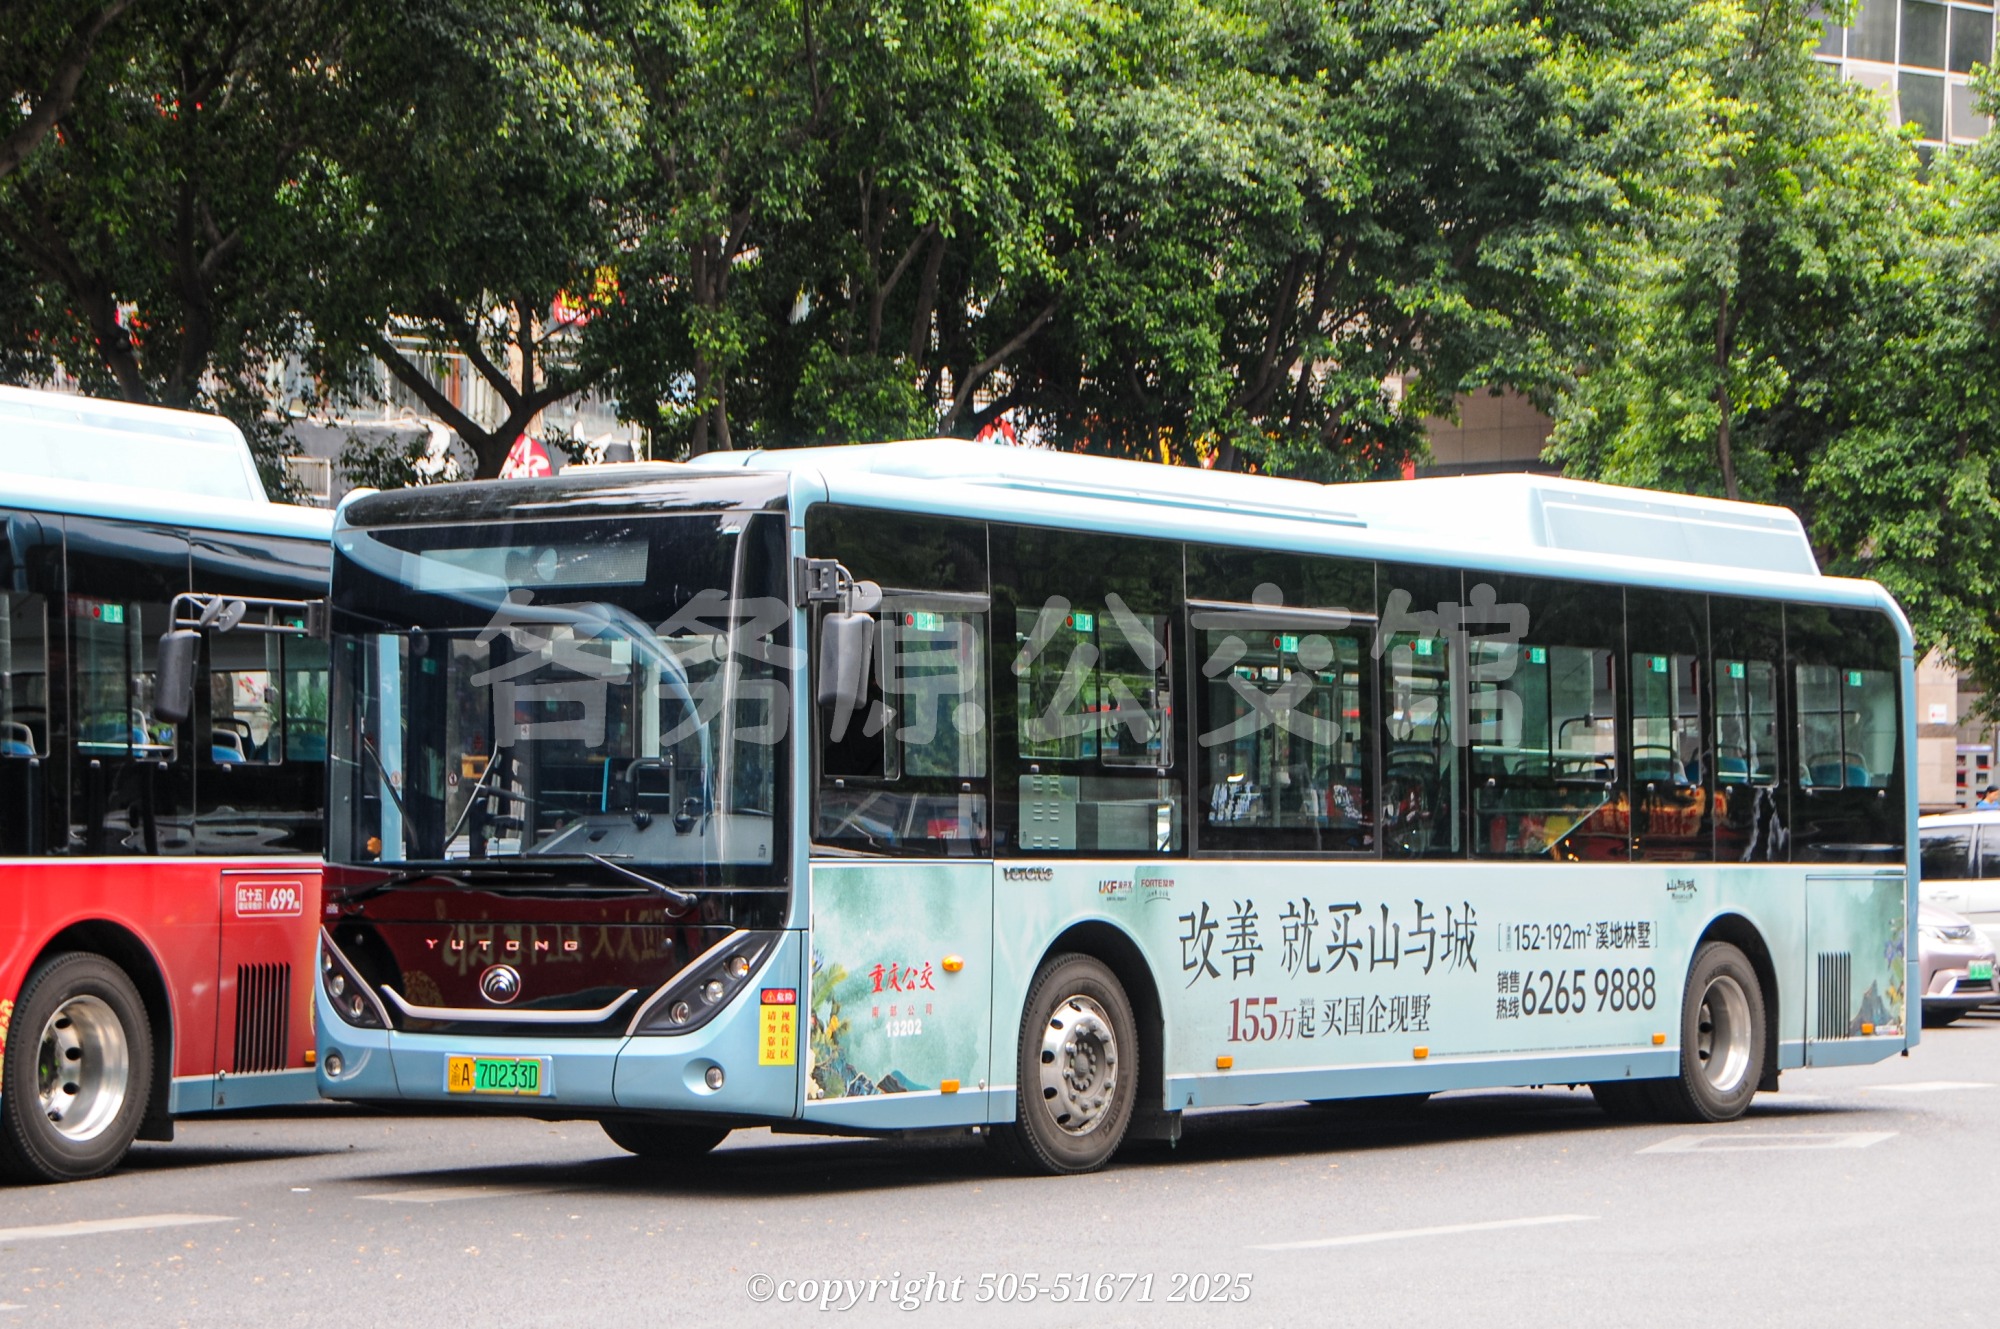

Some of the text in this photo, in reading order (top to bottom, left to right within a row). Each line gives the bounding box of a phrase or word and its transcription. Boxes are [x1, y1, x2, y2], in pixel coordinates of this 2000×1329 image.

[1003, 867, 1054, 881] YUTONG
[239, 888, 262, 901] 红十五
[426, 938, 579, 951] YUTONG
[1178, 897, 1478, 989] 改善 就买山与城
[1595, 921, 1651, 950] 溪地林墅
[868, 961, 936, 993] 重庆公交
[1497, 969, 1520, 994] 销售
[776, 992, 793, 1002] 危险
[1521, 967, 1657, 1016] 6265 9888
[1321, 993, 1431, 1038] 买国企现墅
[1496, 996, 1520, 1020] 热线
[766, 1010, 776, 1060] 请勿靠近
[780, 1010, 790, 1060] 视线盲区
[885, 1018, 922, 1038] 13202
[479, 1063, 539, 1089] 70233D
